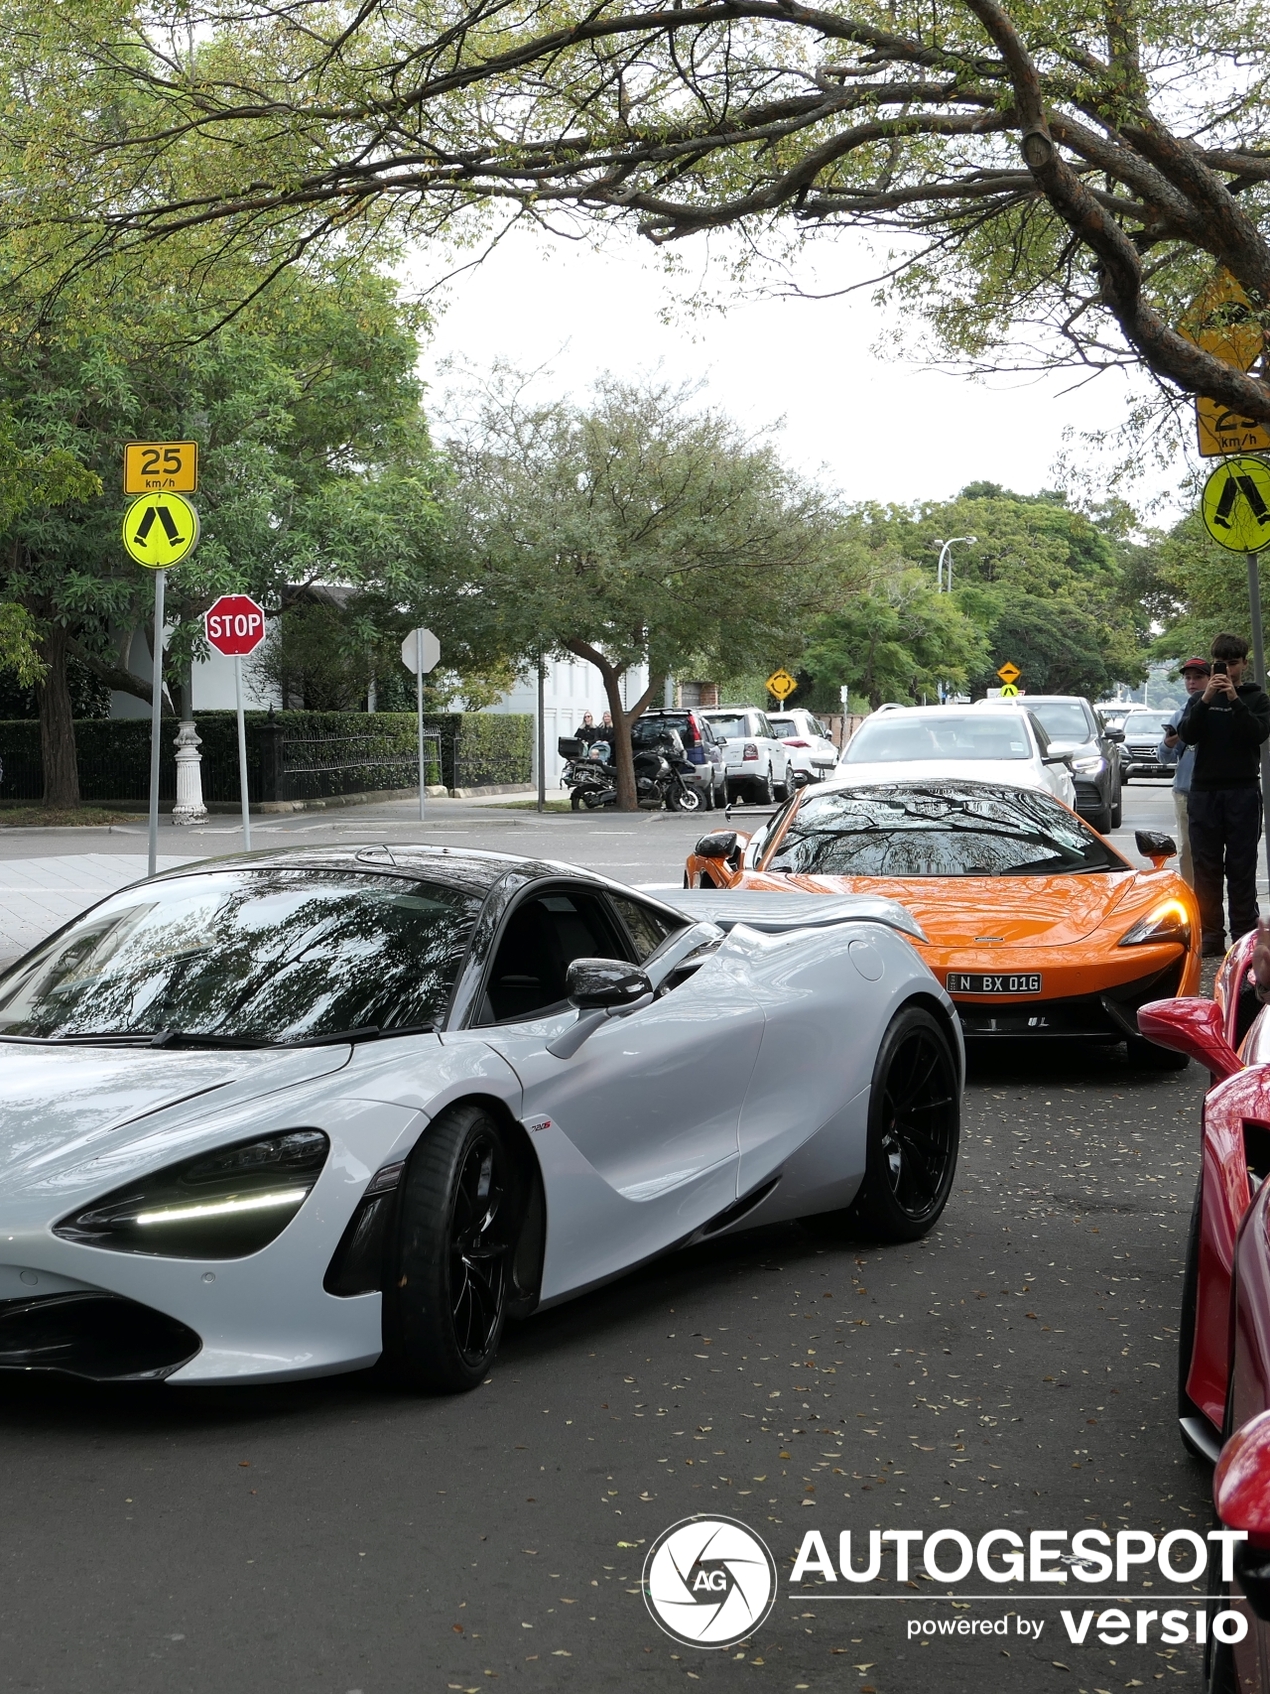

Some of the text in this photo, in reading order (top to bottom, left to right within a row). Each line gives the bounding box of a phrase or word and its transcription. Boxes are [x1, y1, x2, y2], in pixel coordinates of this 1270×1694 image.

[1221, 433, 1257, 448] km/h
[140, 448, 183, 476] 25
[145, 478, 176, 488] km/h
[209, 613, 261, 638] STOP
[960, 976, 970, 990] N
[983, 977, 1003, 991] BX
